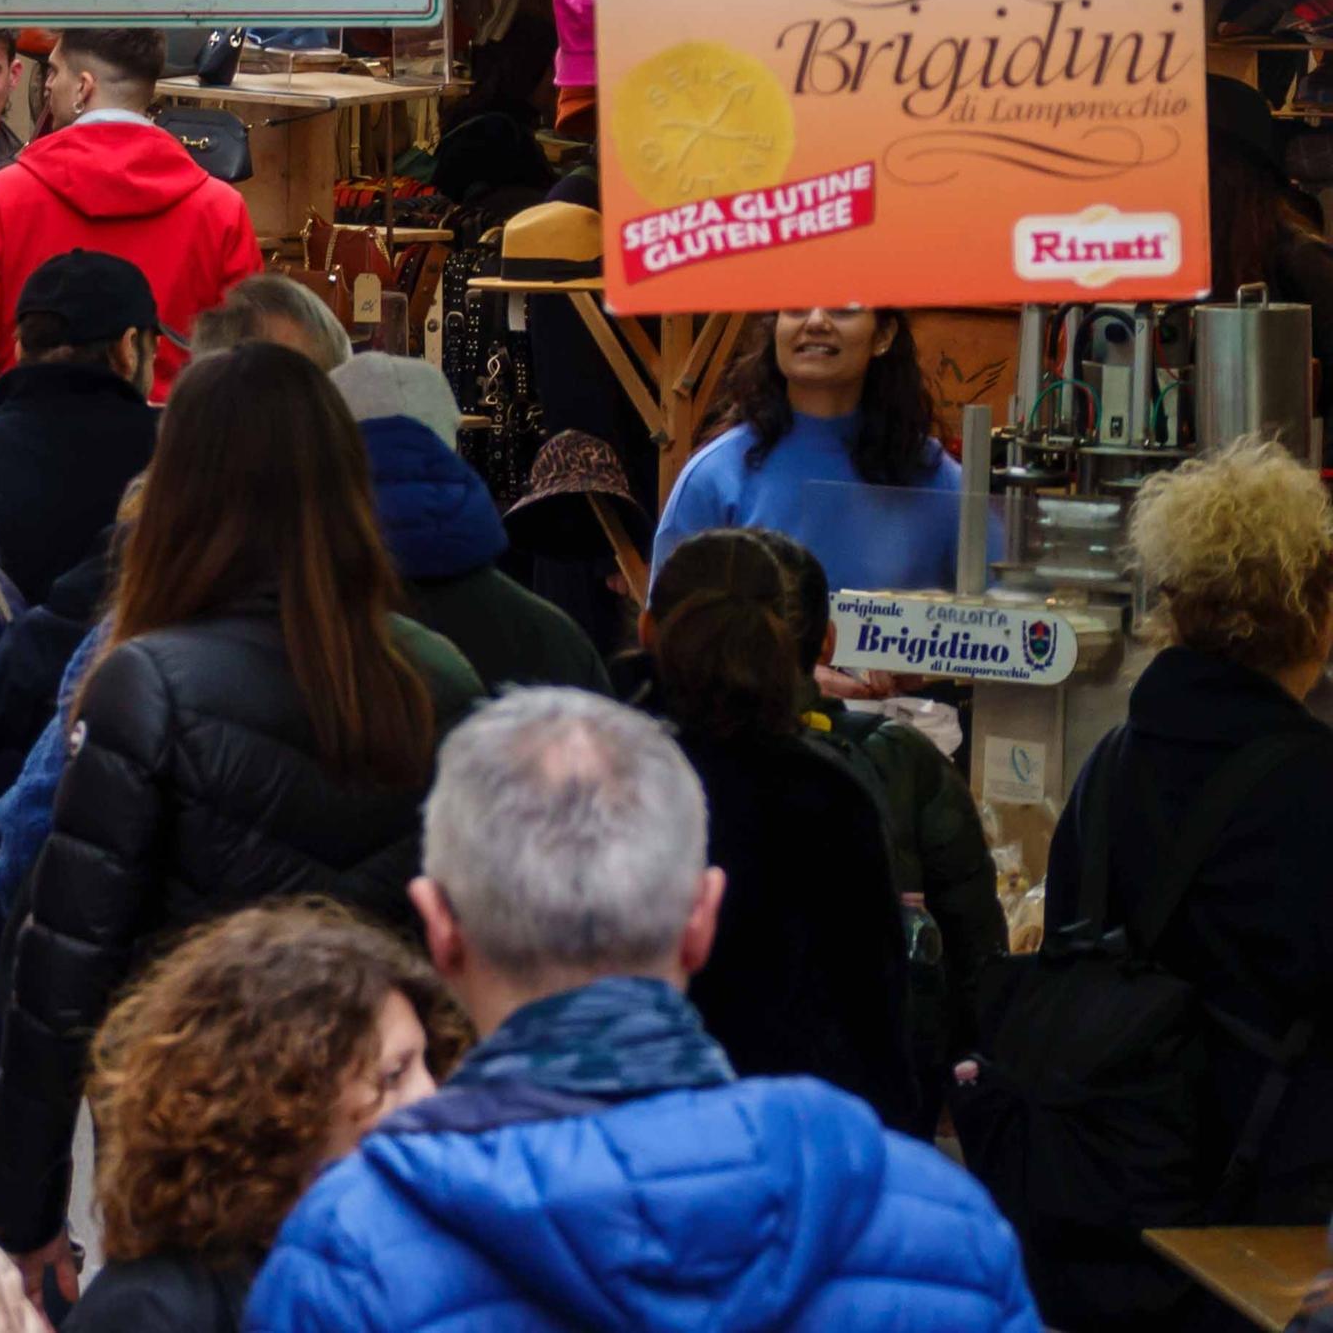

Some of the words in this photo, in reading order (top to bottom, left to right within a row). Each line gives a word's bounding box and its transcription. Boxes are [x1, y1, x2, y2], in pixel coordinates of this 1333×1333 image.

[776, 0, 1194, 120] Brigidini
[949, 95, 977, 124] di
[988, 89, 1190, 127] Lamporecchio
[623, 199, 725, 250] SENZA
[731, 164, 871, 220] GLUTINE
[643, 221, 772, 272] GLUTEN
[779, 195, 853, 240] FREE
[1031, 232, 1164, 263] Rinati
[855, 623, 1010, 664] Brigidino
[930, 661, 942, 673] di
[946, 662, 1031, 680] Lamporecchio
